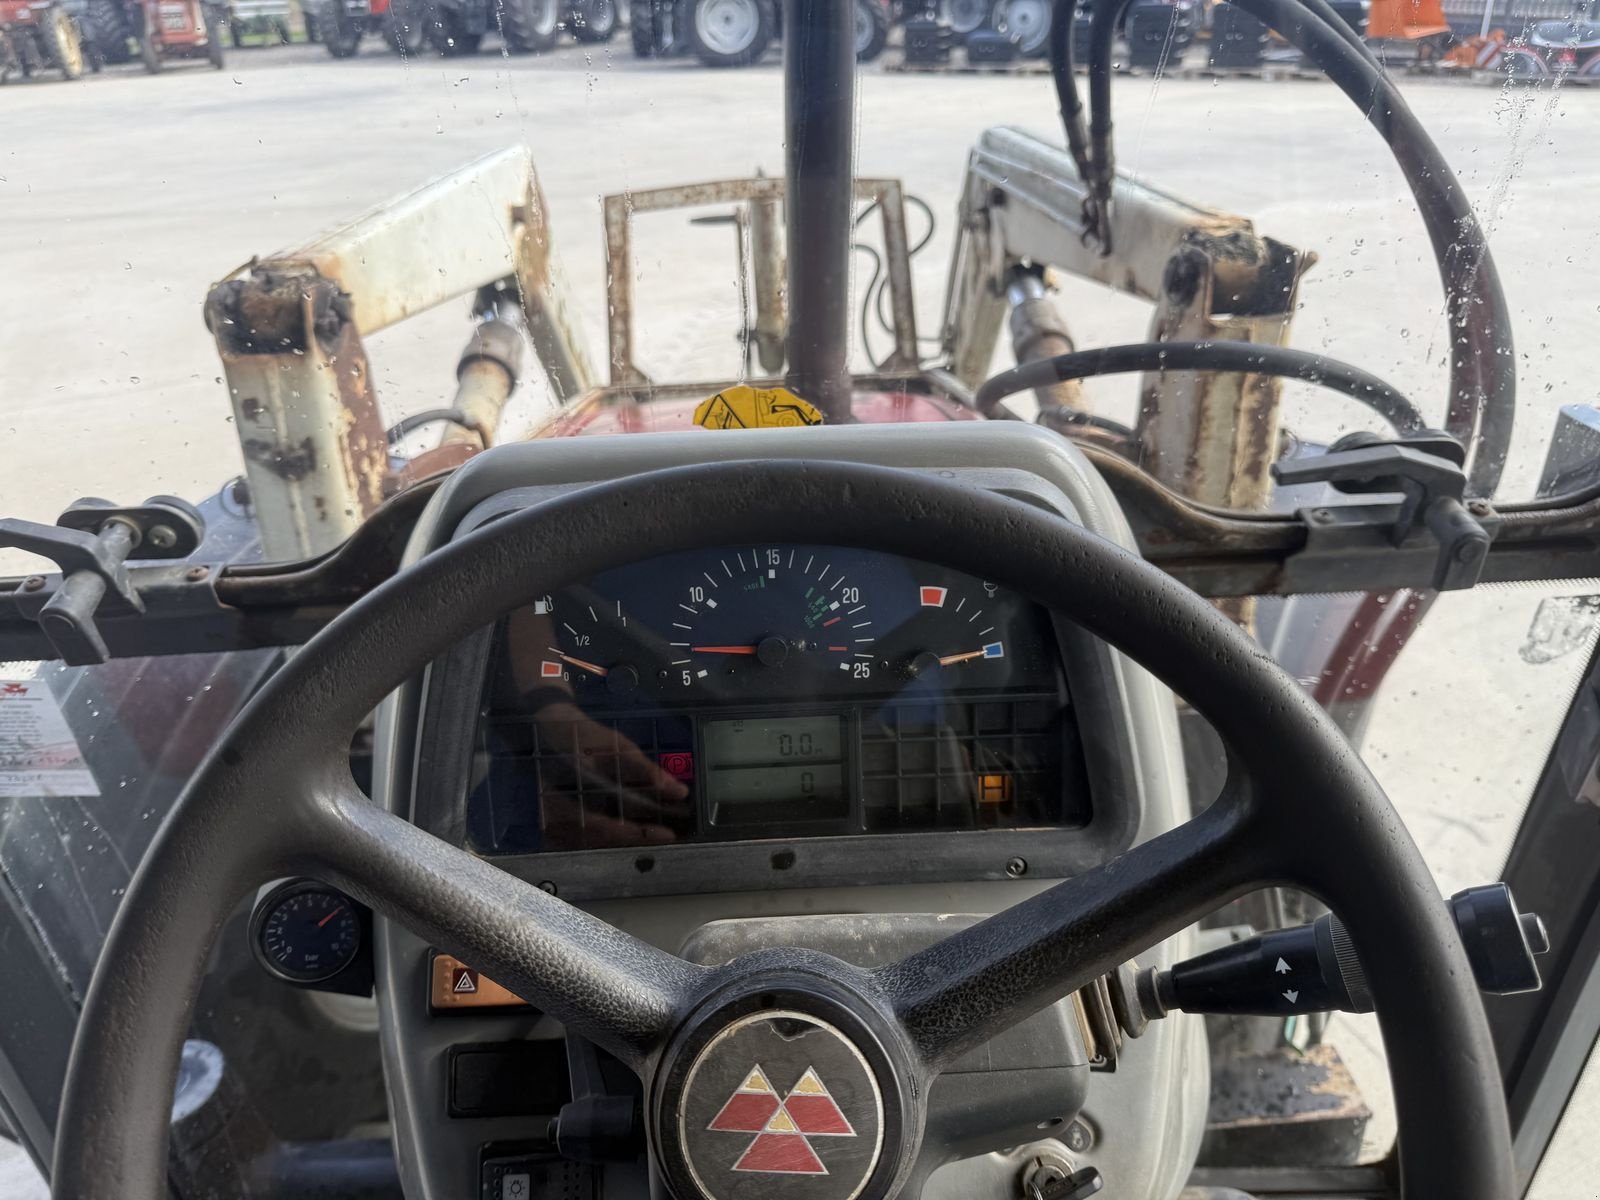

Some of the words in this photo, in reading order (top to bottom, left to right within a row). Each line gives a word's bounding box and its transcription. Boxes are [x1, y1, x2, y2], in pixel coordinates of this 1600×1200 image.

[766, 549, 780, 565] 15
[689, 587, 704, 602] 10
[842, 587, 859, 603] 20
[622, 616, 627, 627] 1
[574, 635, 590, 646] 1/2
[563, 671, 570, 682] 0
[682, 670, 691, 686] 5
[853, 662, 870, 679] 25
[801, 772, 814, 793] 0
